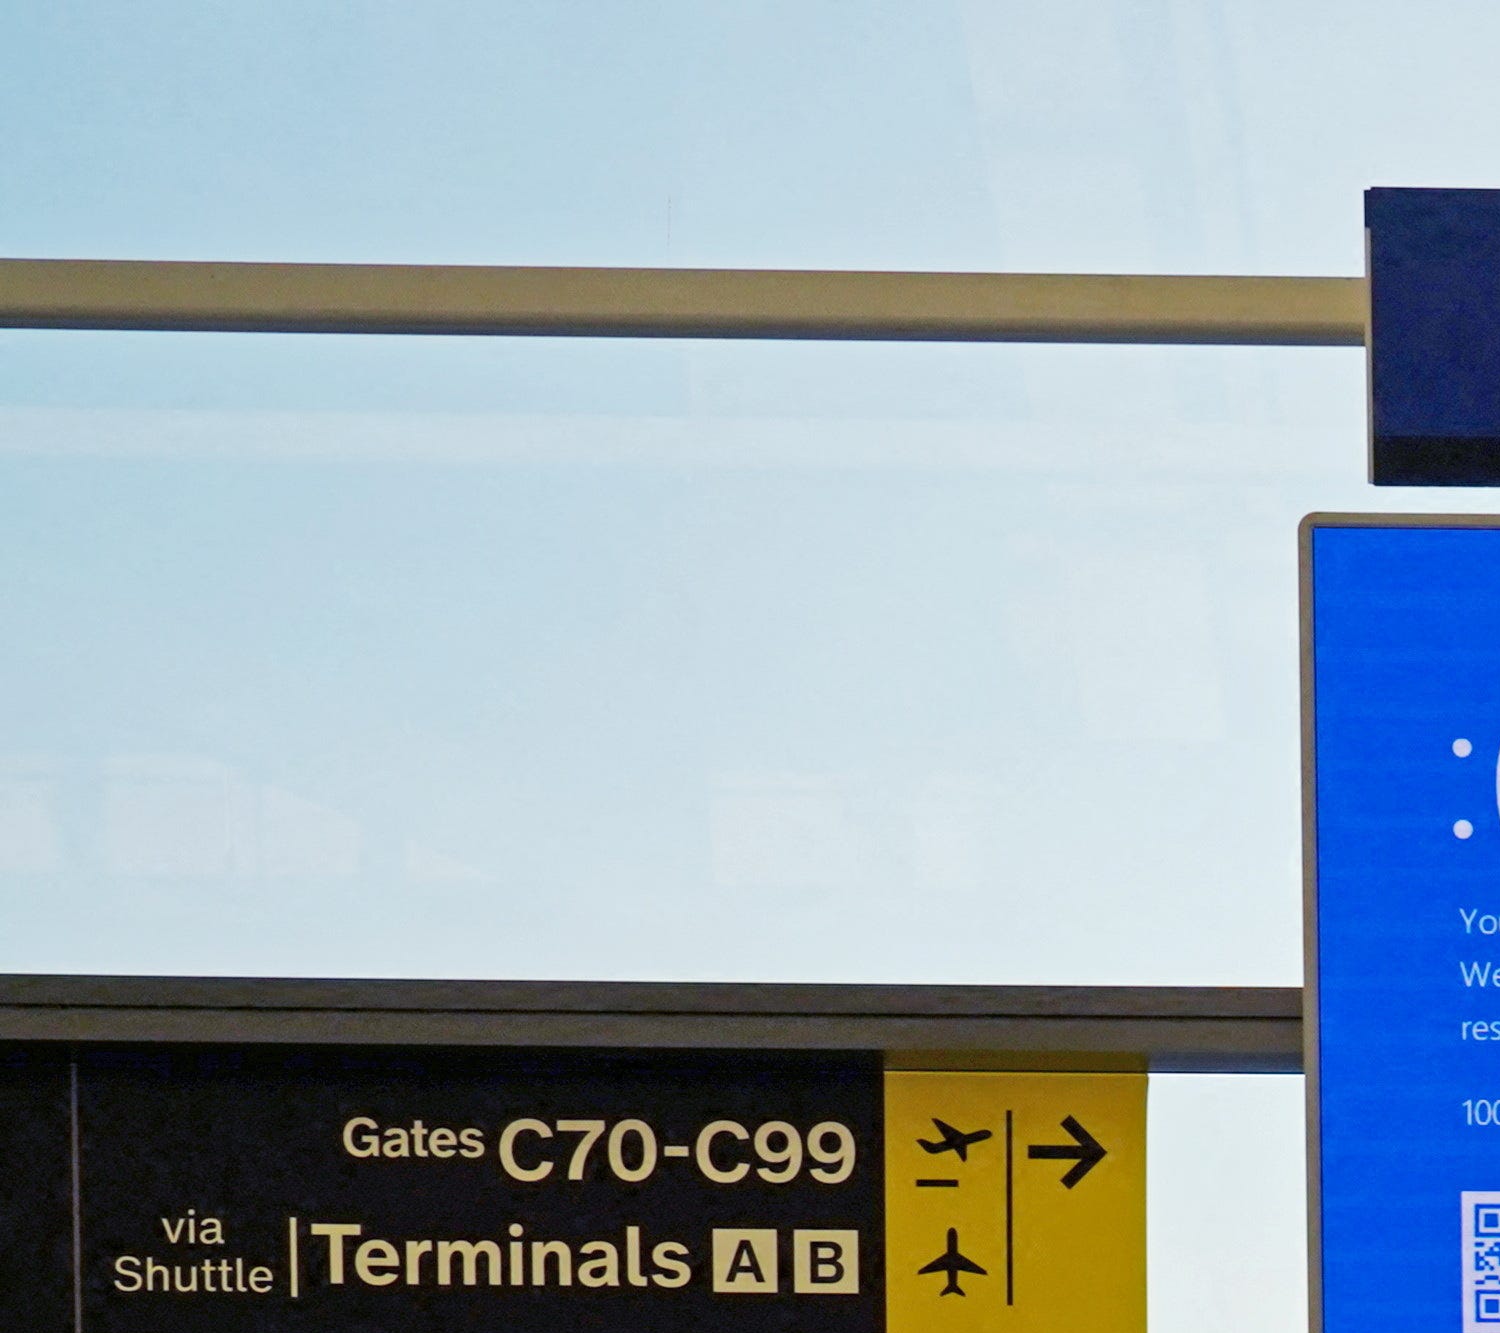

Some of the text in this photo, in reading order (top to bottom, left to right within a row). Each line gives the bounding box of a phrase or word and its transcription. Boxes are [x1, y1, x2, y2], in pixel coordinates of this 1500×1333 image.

[342, 1116, 856, 1185] Gates C70-C99
[161, 1208, 226, 1245] via
[113, 1255, 274, 1294] Shuttle
[310, 1222, 845, 1289] Terminals A B
